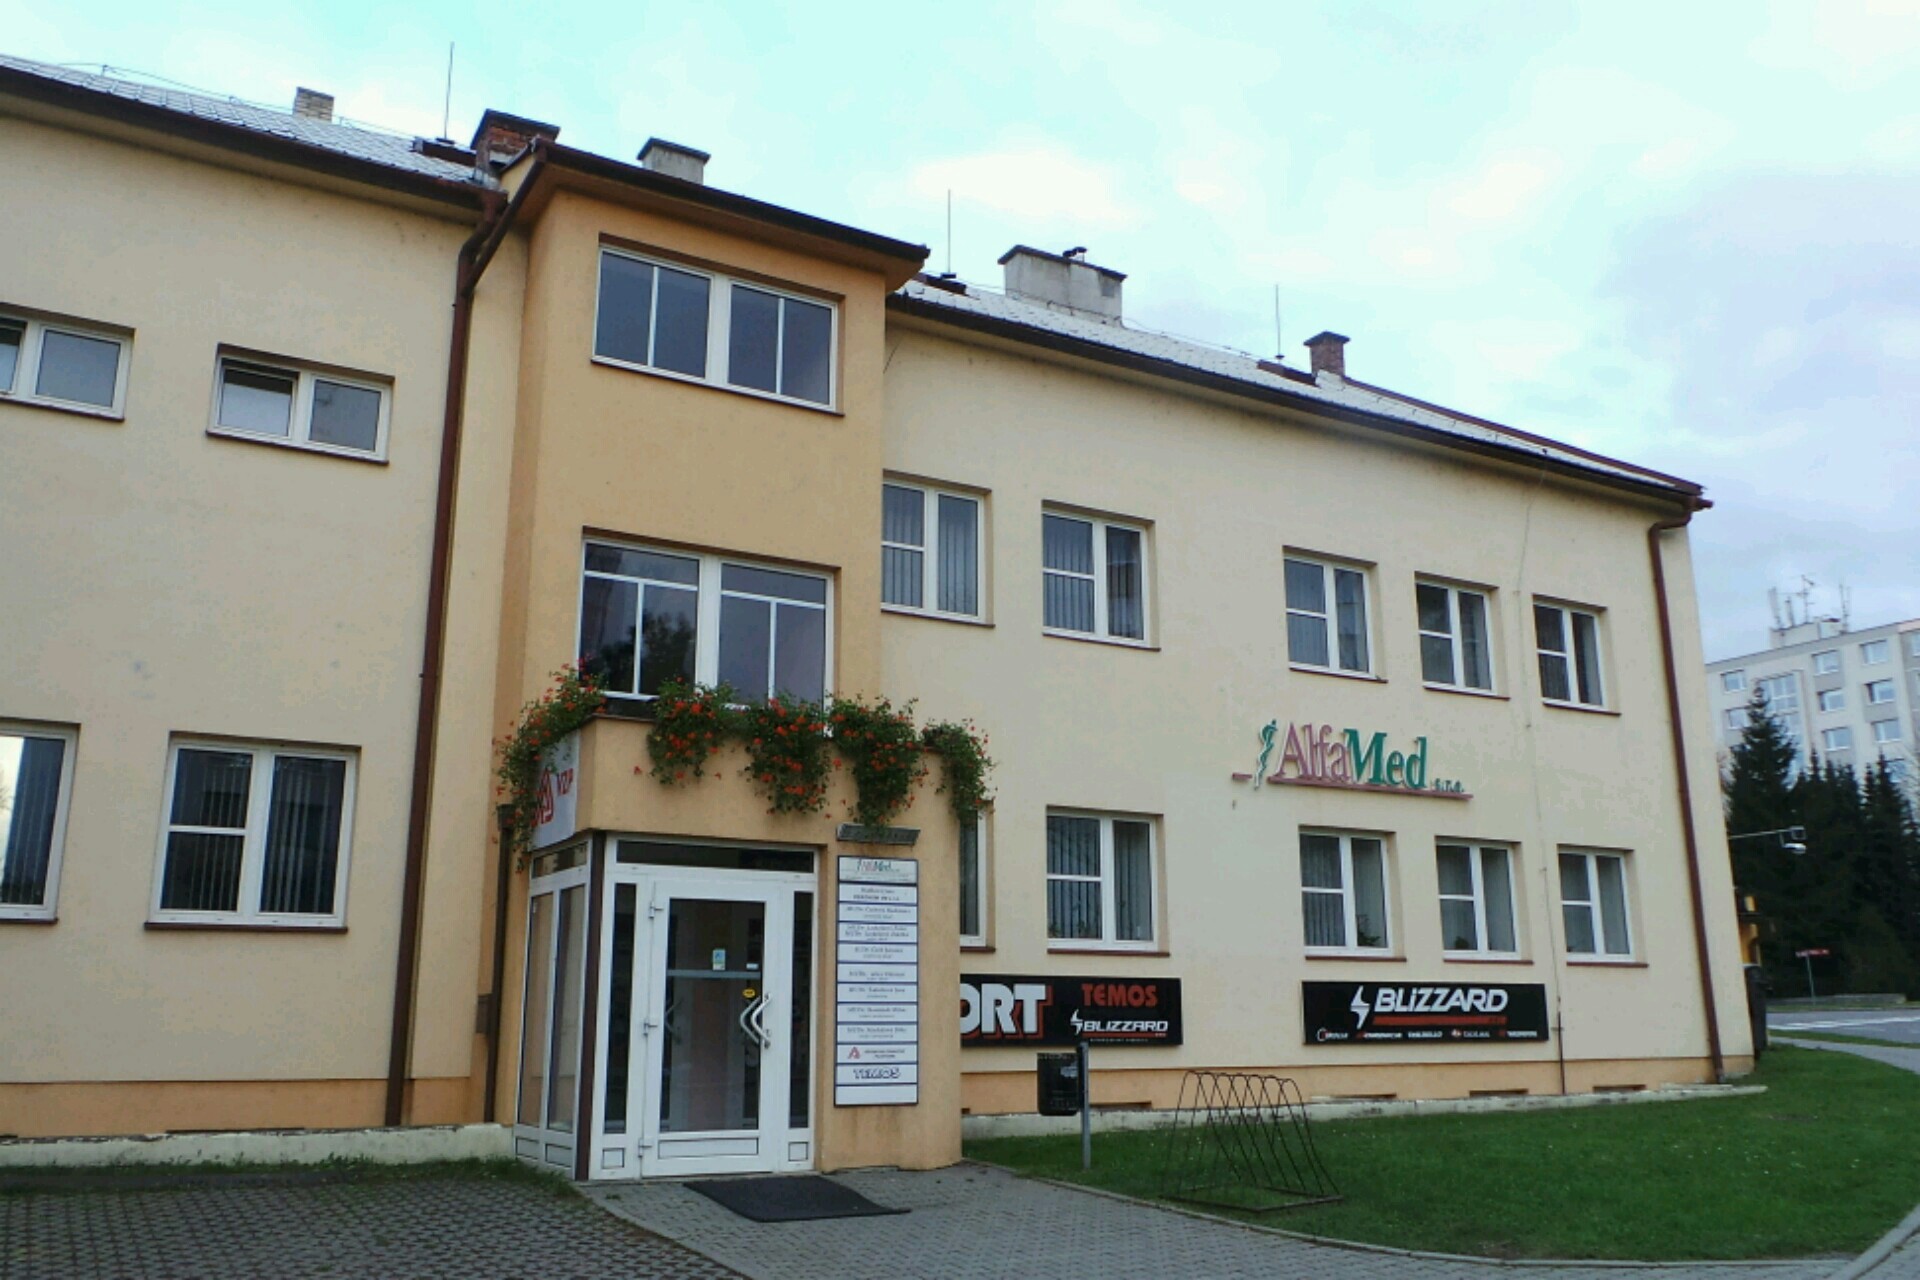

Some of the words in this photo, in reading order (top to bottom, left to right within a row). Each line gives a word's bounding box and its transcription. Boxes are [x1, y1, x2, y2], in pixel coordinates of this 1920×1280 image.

[1276, 722, 1427, 789] AlfaMed
[1081, 983, 1158, 1007] TEMOS
[1083, 1020, 1168, 1032] BLIZZARD
